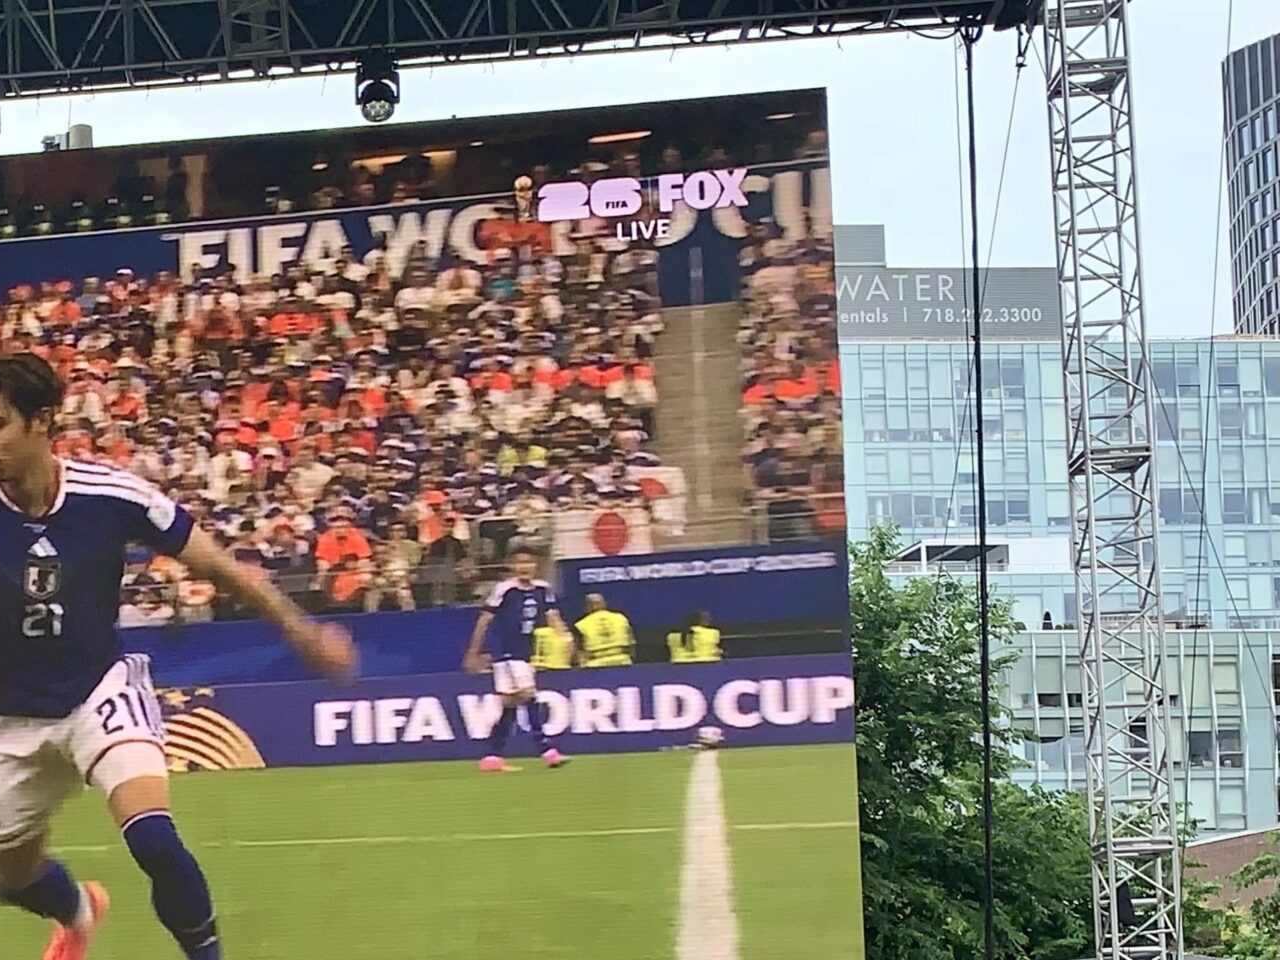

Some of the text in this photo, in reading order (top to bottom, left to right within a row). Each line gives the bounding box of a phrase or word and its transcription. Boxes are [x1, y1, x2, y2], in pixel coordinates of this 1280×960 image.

[604, 199, 628, 210] FIFA
[658, 168, 749, 212] FOX
[616, 219, 670, 242] LIVE
[837, 307, 1042, 323] entals 718.22.3300
[21, 602, 64, 637] 21
[97, 692, 139, 735] 21
[313, 696, 455, 747] FIFA
[713, 676, 854, 728] CUP
